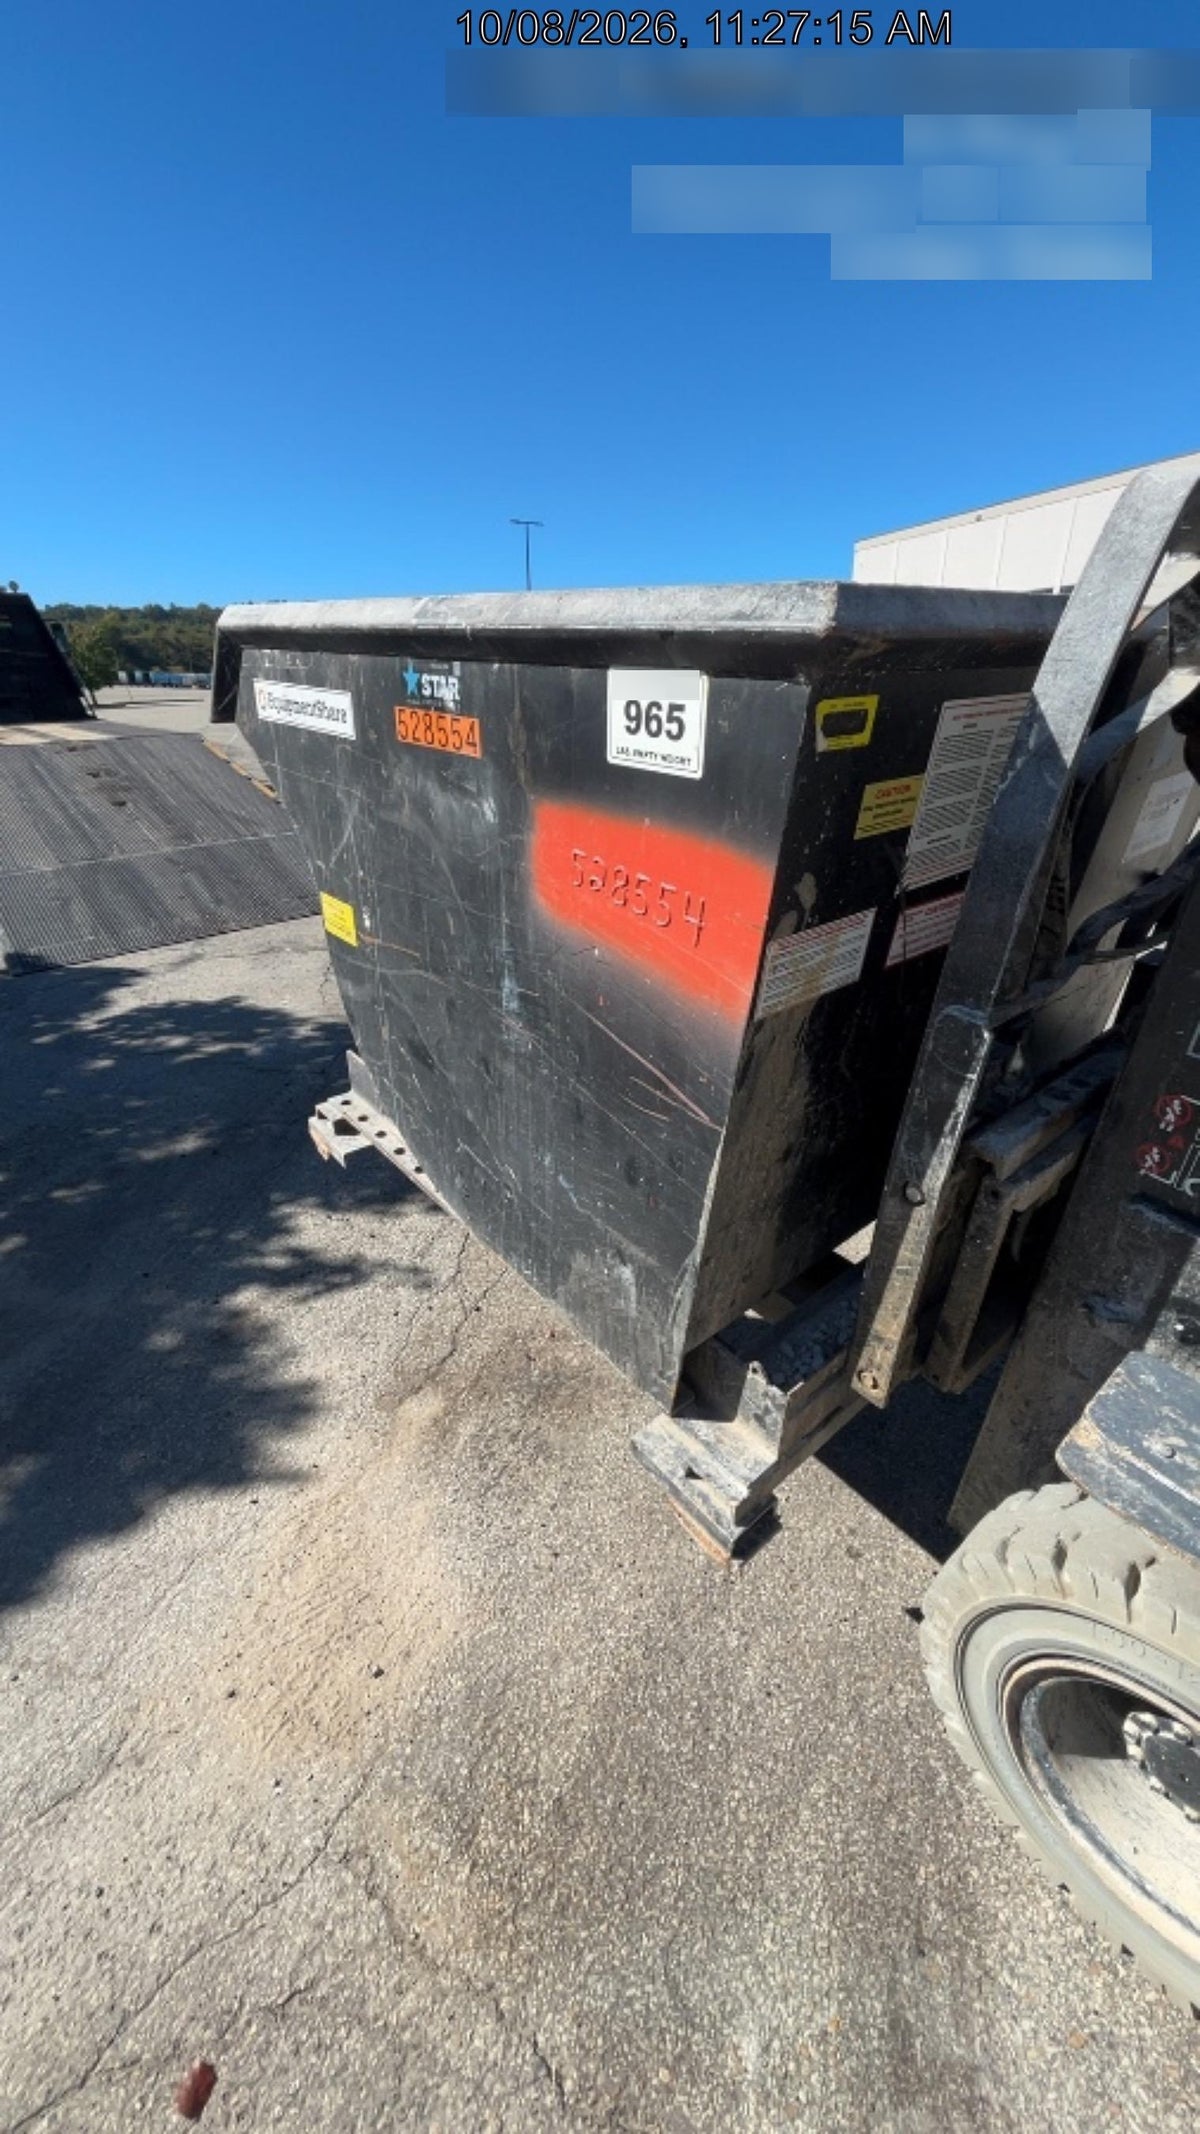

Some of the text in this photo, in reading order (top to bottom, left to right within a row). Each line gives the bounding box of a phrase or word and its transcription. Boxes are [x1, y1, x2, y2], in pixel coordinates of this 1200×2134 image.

[421, 672, 461, 700] STAR
[398, 708, 478, 755] 528554
[624, 699, 686, 742] 965
[572, 848, 705, 948] 528554
